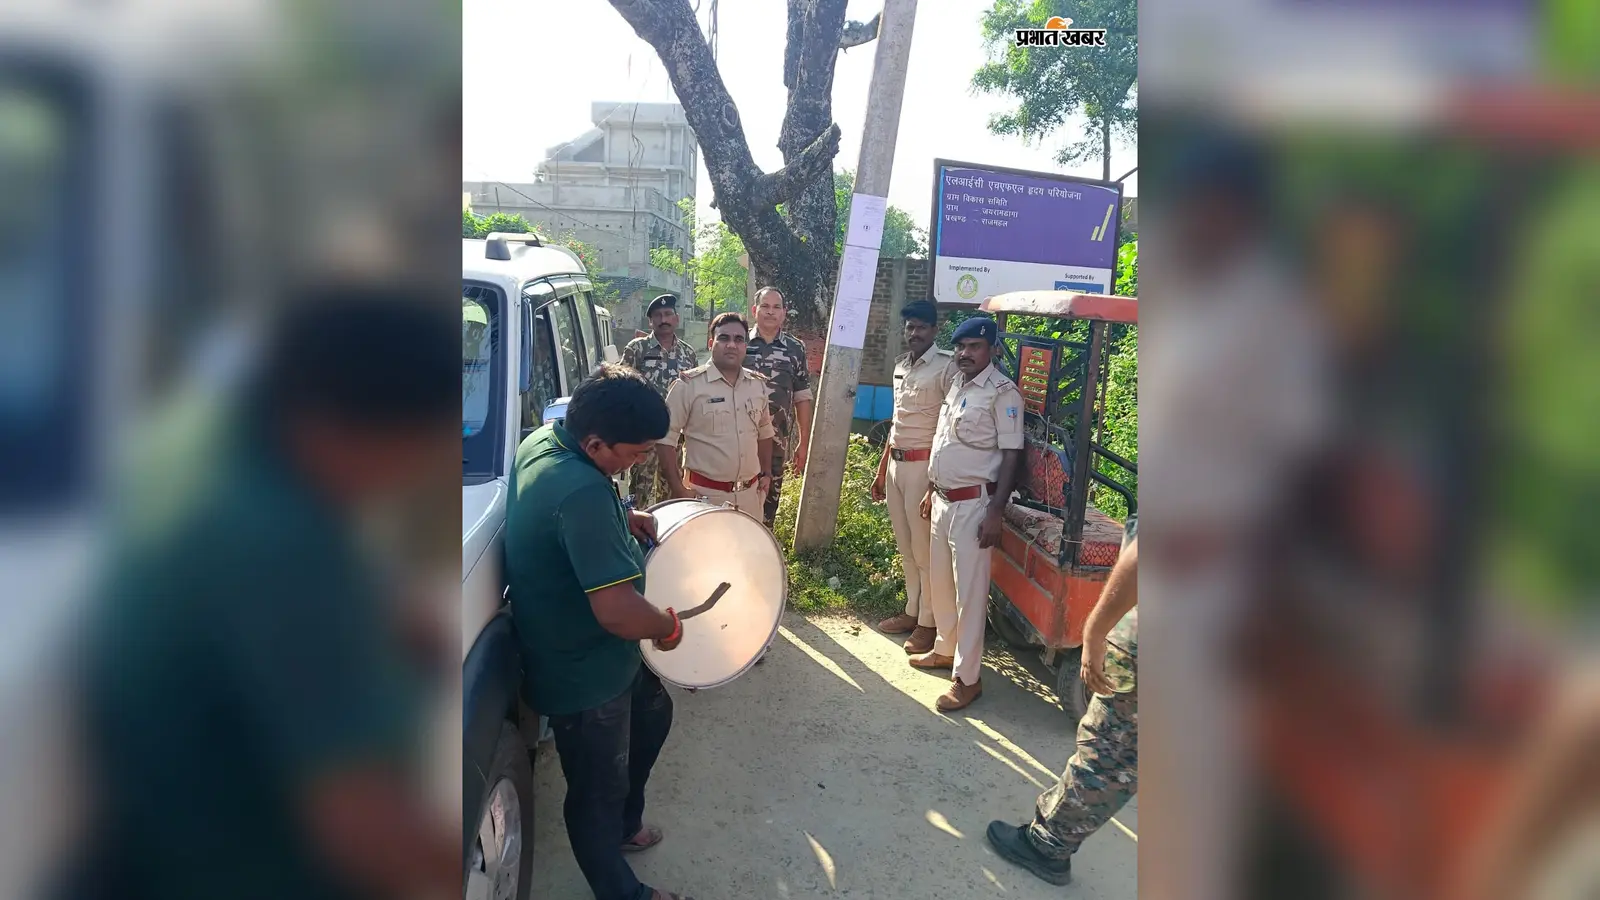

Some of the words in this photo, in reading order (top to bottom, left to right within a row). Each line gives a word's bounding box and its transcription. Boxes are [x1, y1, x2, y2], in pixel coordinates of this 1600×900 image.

[945, 175, 984, 189] एलआईसी
[988, 181, 1024, 193] एचएफएल
[1048, 187, 1082, 200] परियोजना
[946, 193, 960, 201] ग्राम
[963, 194, 984, 204] विकास
[988, 197, 1008, 206] समिति
[946, 203, 959, 211] ग्राम
[981, 218, 1008, 227] राजमहल
[949, 264, 983, 273] Implemented
[1064, 273, 1088, 281] Supported
[1088, 274, 1095, 282] By
